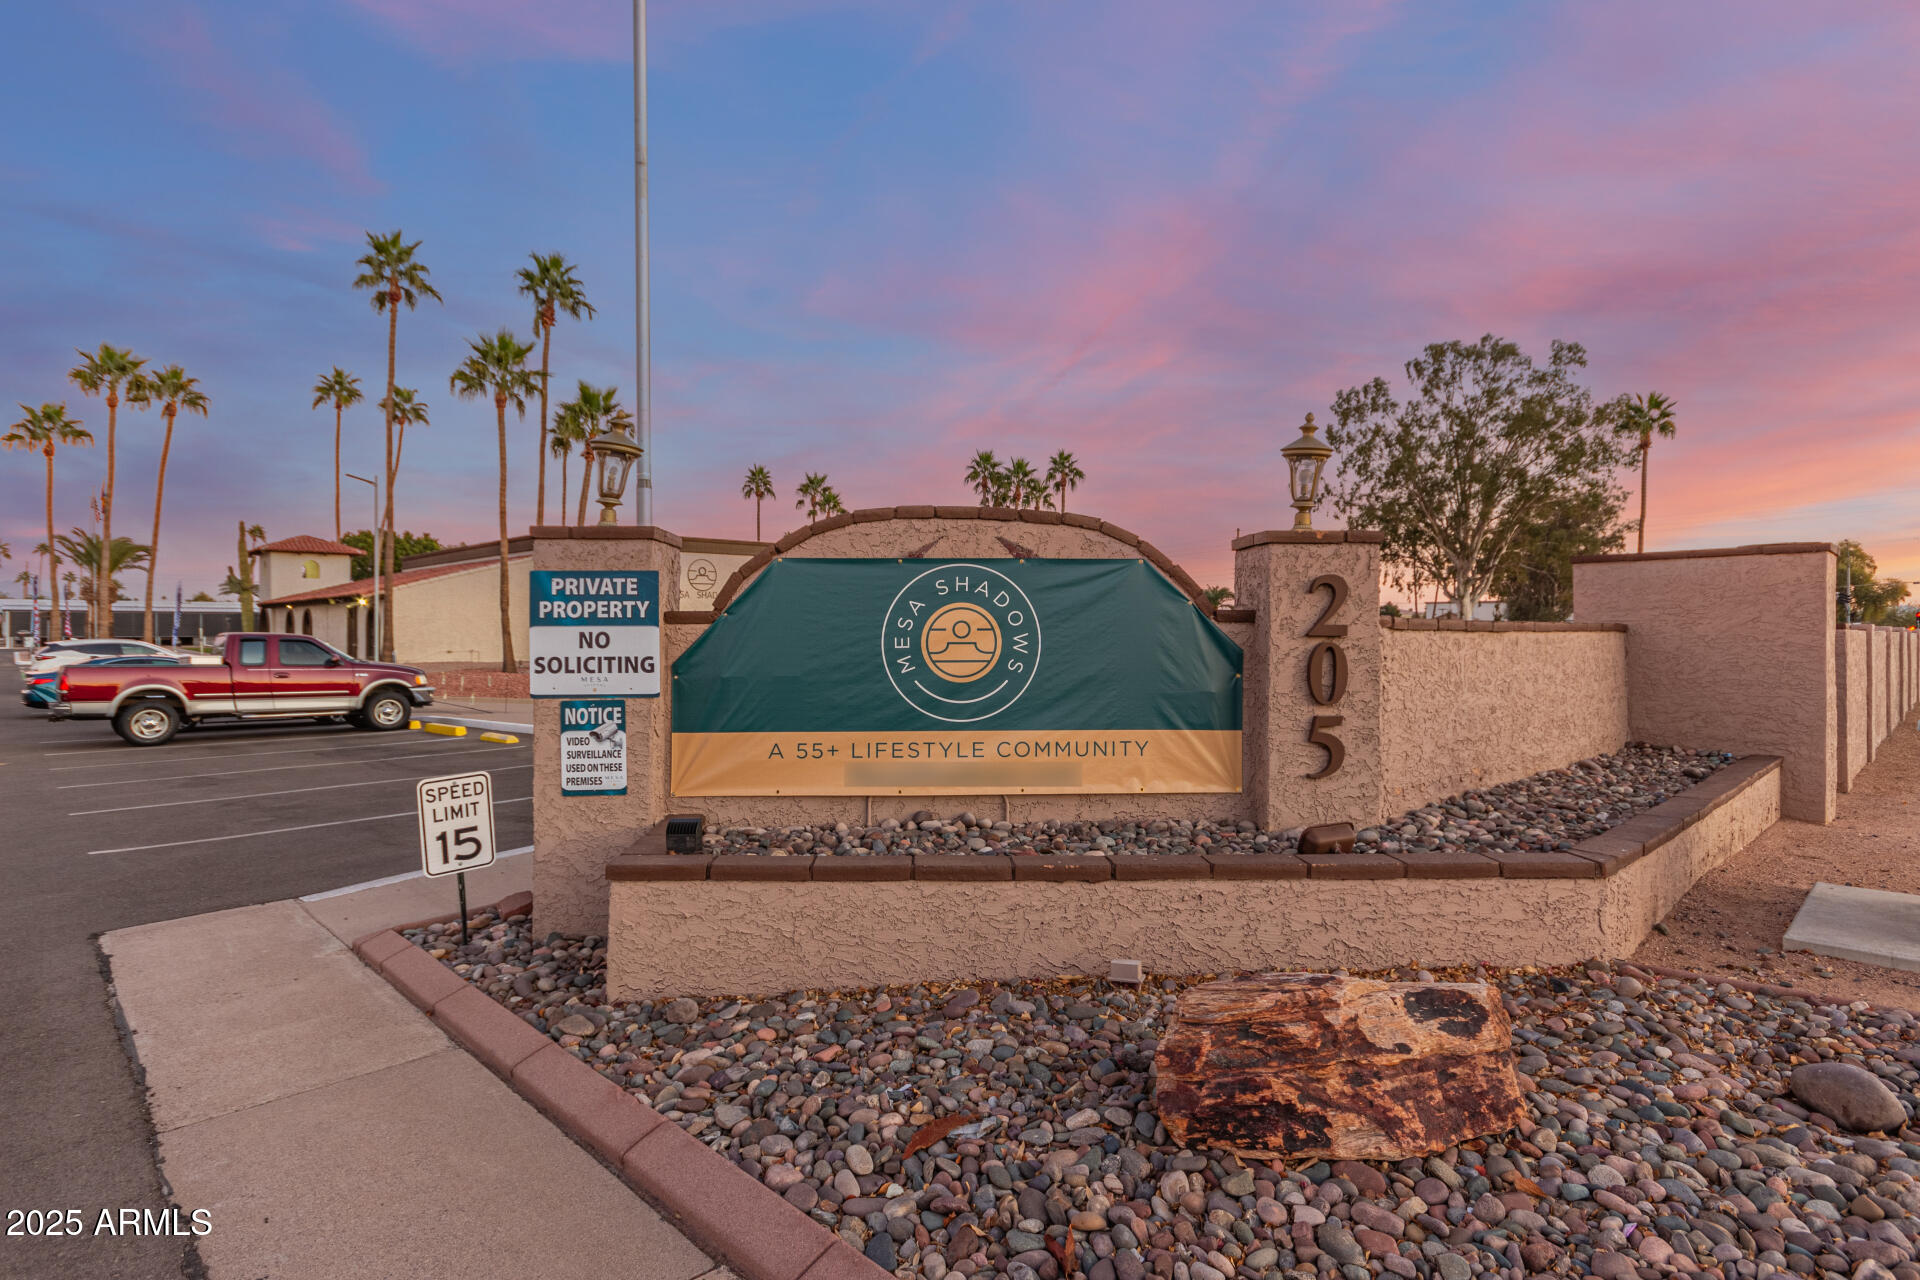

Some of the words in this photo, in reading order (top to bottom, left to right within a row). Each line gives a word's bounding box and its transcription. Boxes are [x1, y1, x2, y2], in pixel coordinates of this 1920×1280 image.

[551, 577, 638, 596] PRIVATE
[538, 600, 650, 619] PROPERTY
[894, 600, 926, 674] MESA
[935, 576, 1029, 673] SHADOWS
[578, 631, 611, 649] NO
[533, 655, 655, 674] SOLICITING
[1306, 574, 1349, 779] 205
[564, 706, 622, 725] NOTICE
[566, 736, 591, 746] VIDEO
[768, 742, 784, 759] A
[796, 742, 840, 759] 55+
[851, 741, 985, 758] LIFESTYLE
[997, 740, 1149, 758] COMMUNITY
[566, 749, 622, 760] SURVEILLANCE
[566, 763, 586, 773] USED
[587, 763, 599, 772] ON
[600, 762, 623, 772] THESE
[566, 776, 603, 786] PREMISES
[425, 781, 484, 803] SPEED
[433, 801, 479, 823] LIMIT
[436, 825, 482, 865] 15
